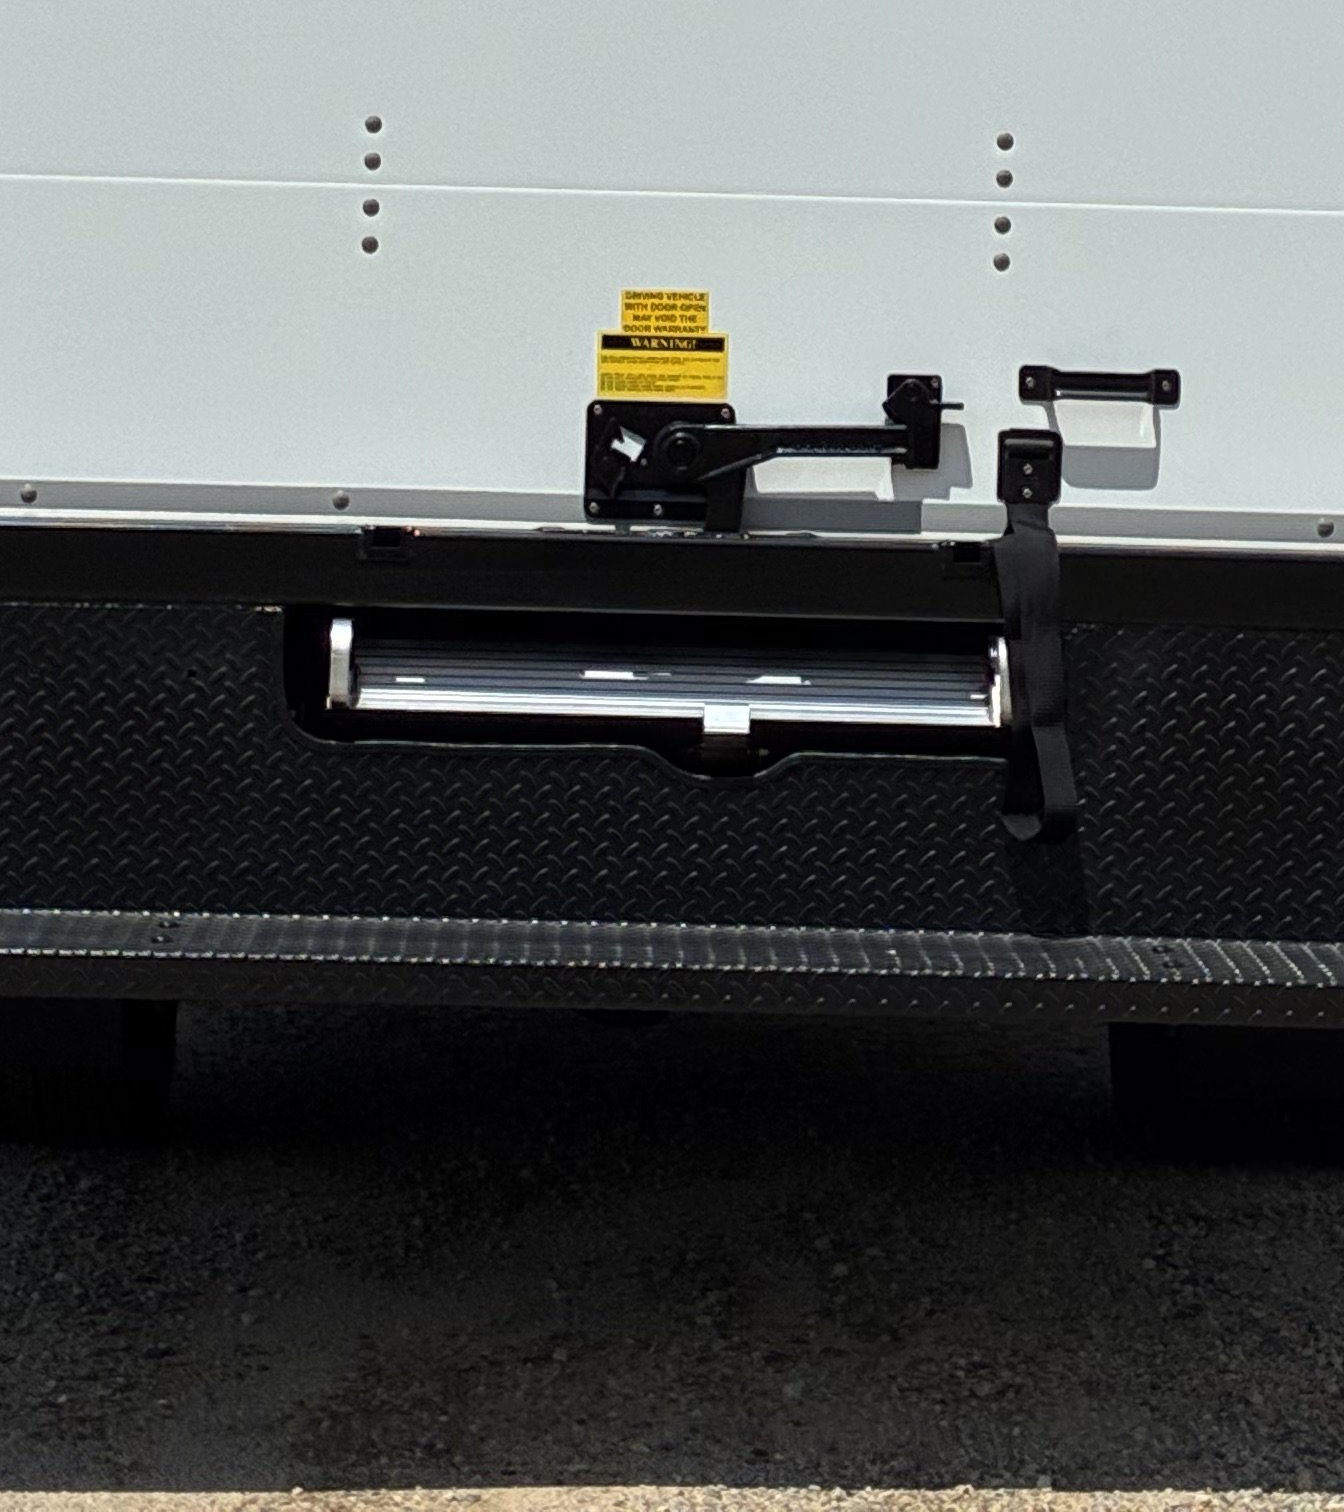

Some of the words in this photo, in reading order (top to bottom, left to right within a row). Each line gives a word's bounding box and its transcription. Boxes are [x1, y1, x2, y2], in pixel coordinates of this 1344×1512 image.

[625, 291, 664, 300] DRIVING
[665, 292, 705, 301] VEHICLE
[624, 302, 648, 311] WITH
[650, 303, 678, 312] DOOR
[679, 303, 706, 312] OPEN
[632, 313, 652, 322] MAY
[654, 314, 677, 322] VOID
[678, 314, 697, 323] THE
[623, 324, 651, 333] DOOR
[653, 325, 706, 334] WARRANTY
[630, 337, 697, 349] WARNING!
